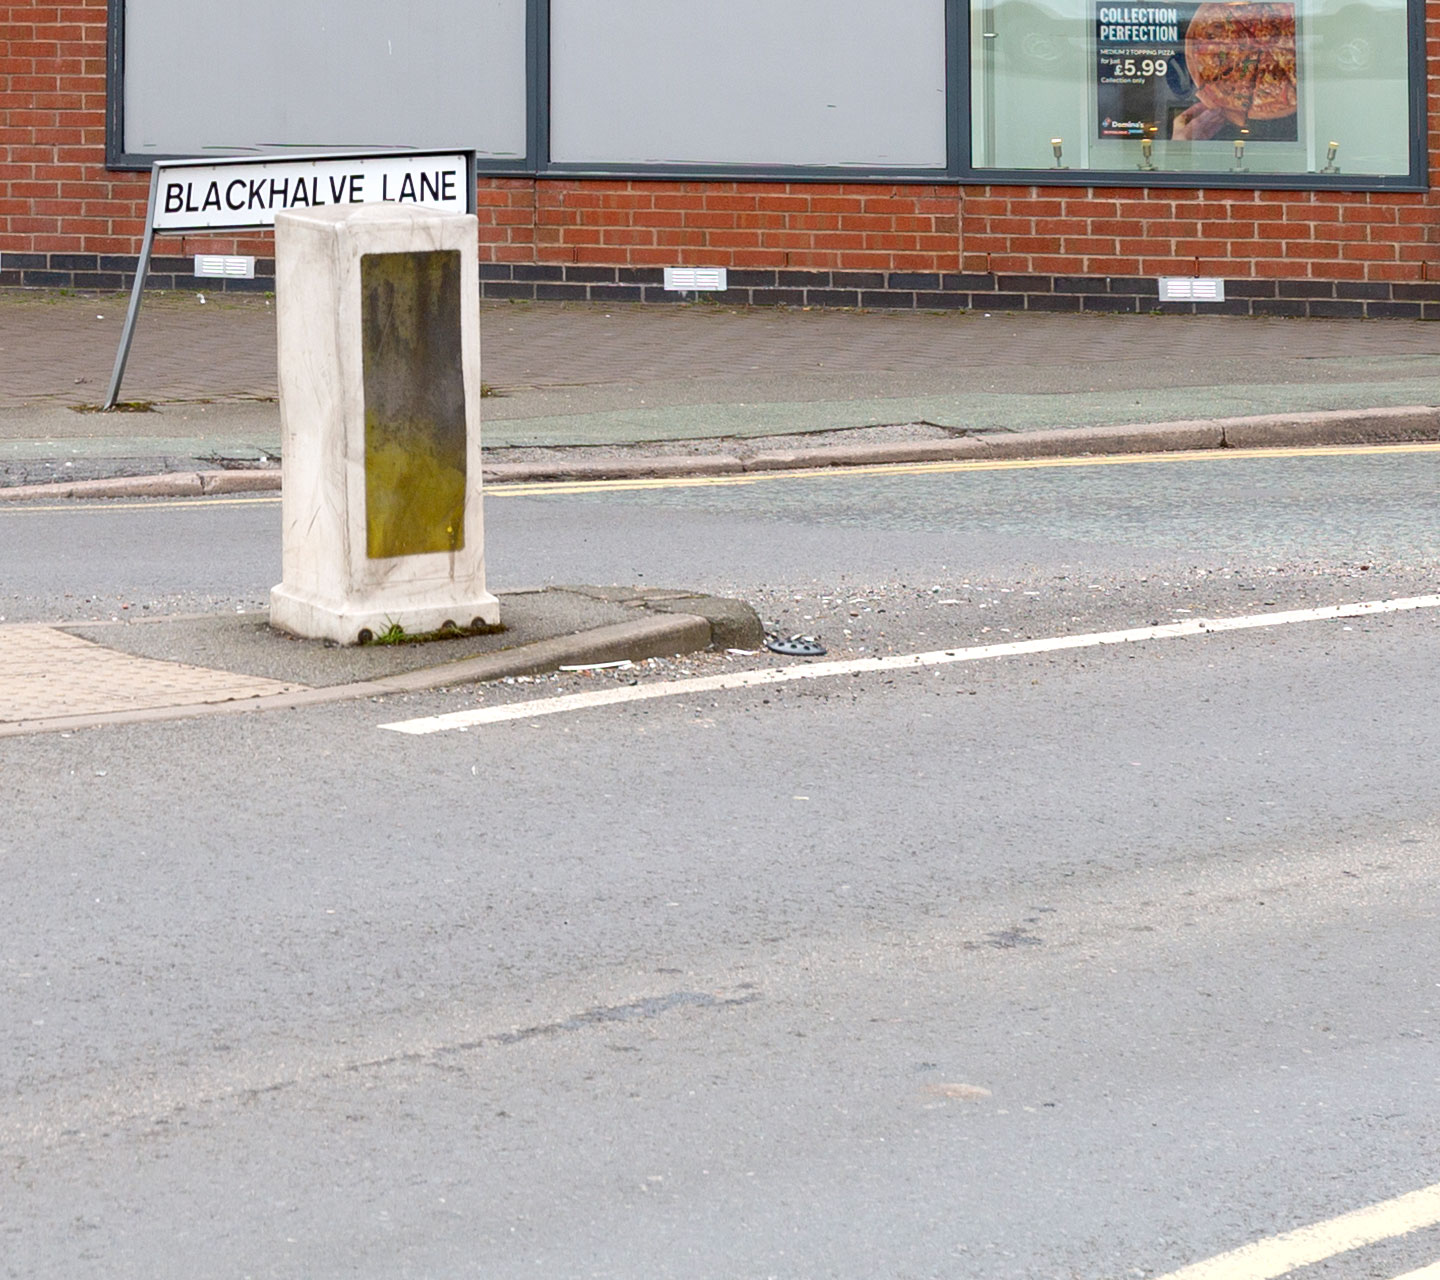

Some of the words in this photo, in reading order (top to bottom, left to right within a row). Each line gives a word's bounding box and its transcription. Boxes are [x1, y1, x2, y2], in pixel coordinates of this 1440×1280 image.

[1100, 8, 1177, 23] COLLECTION
[1100, 25, 1178, 41] PERFECTION
[1114, 59, 1168, 77] £5.99
[1132, 77, 1146, 85] only
[1112, 120, 1144, 128] Domino's
[164, 174, 365, 214] BLACKHALVE
[382, 170, 458, 203] LANE
